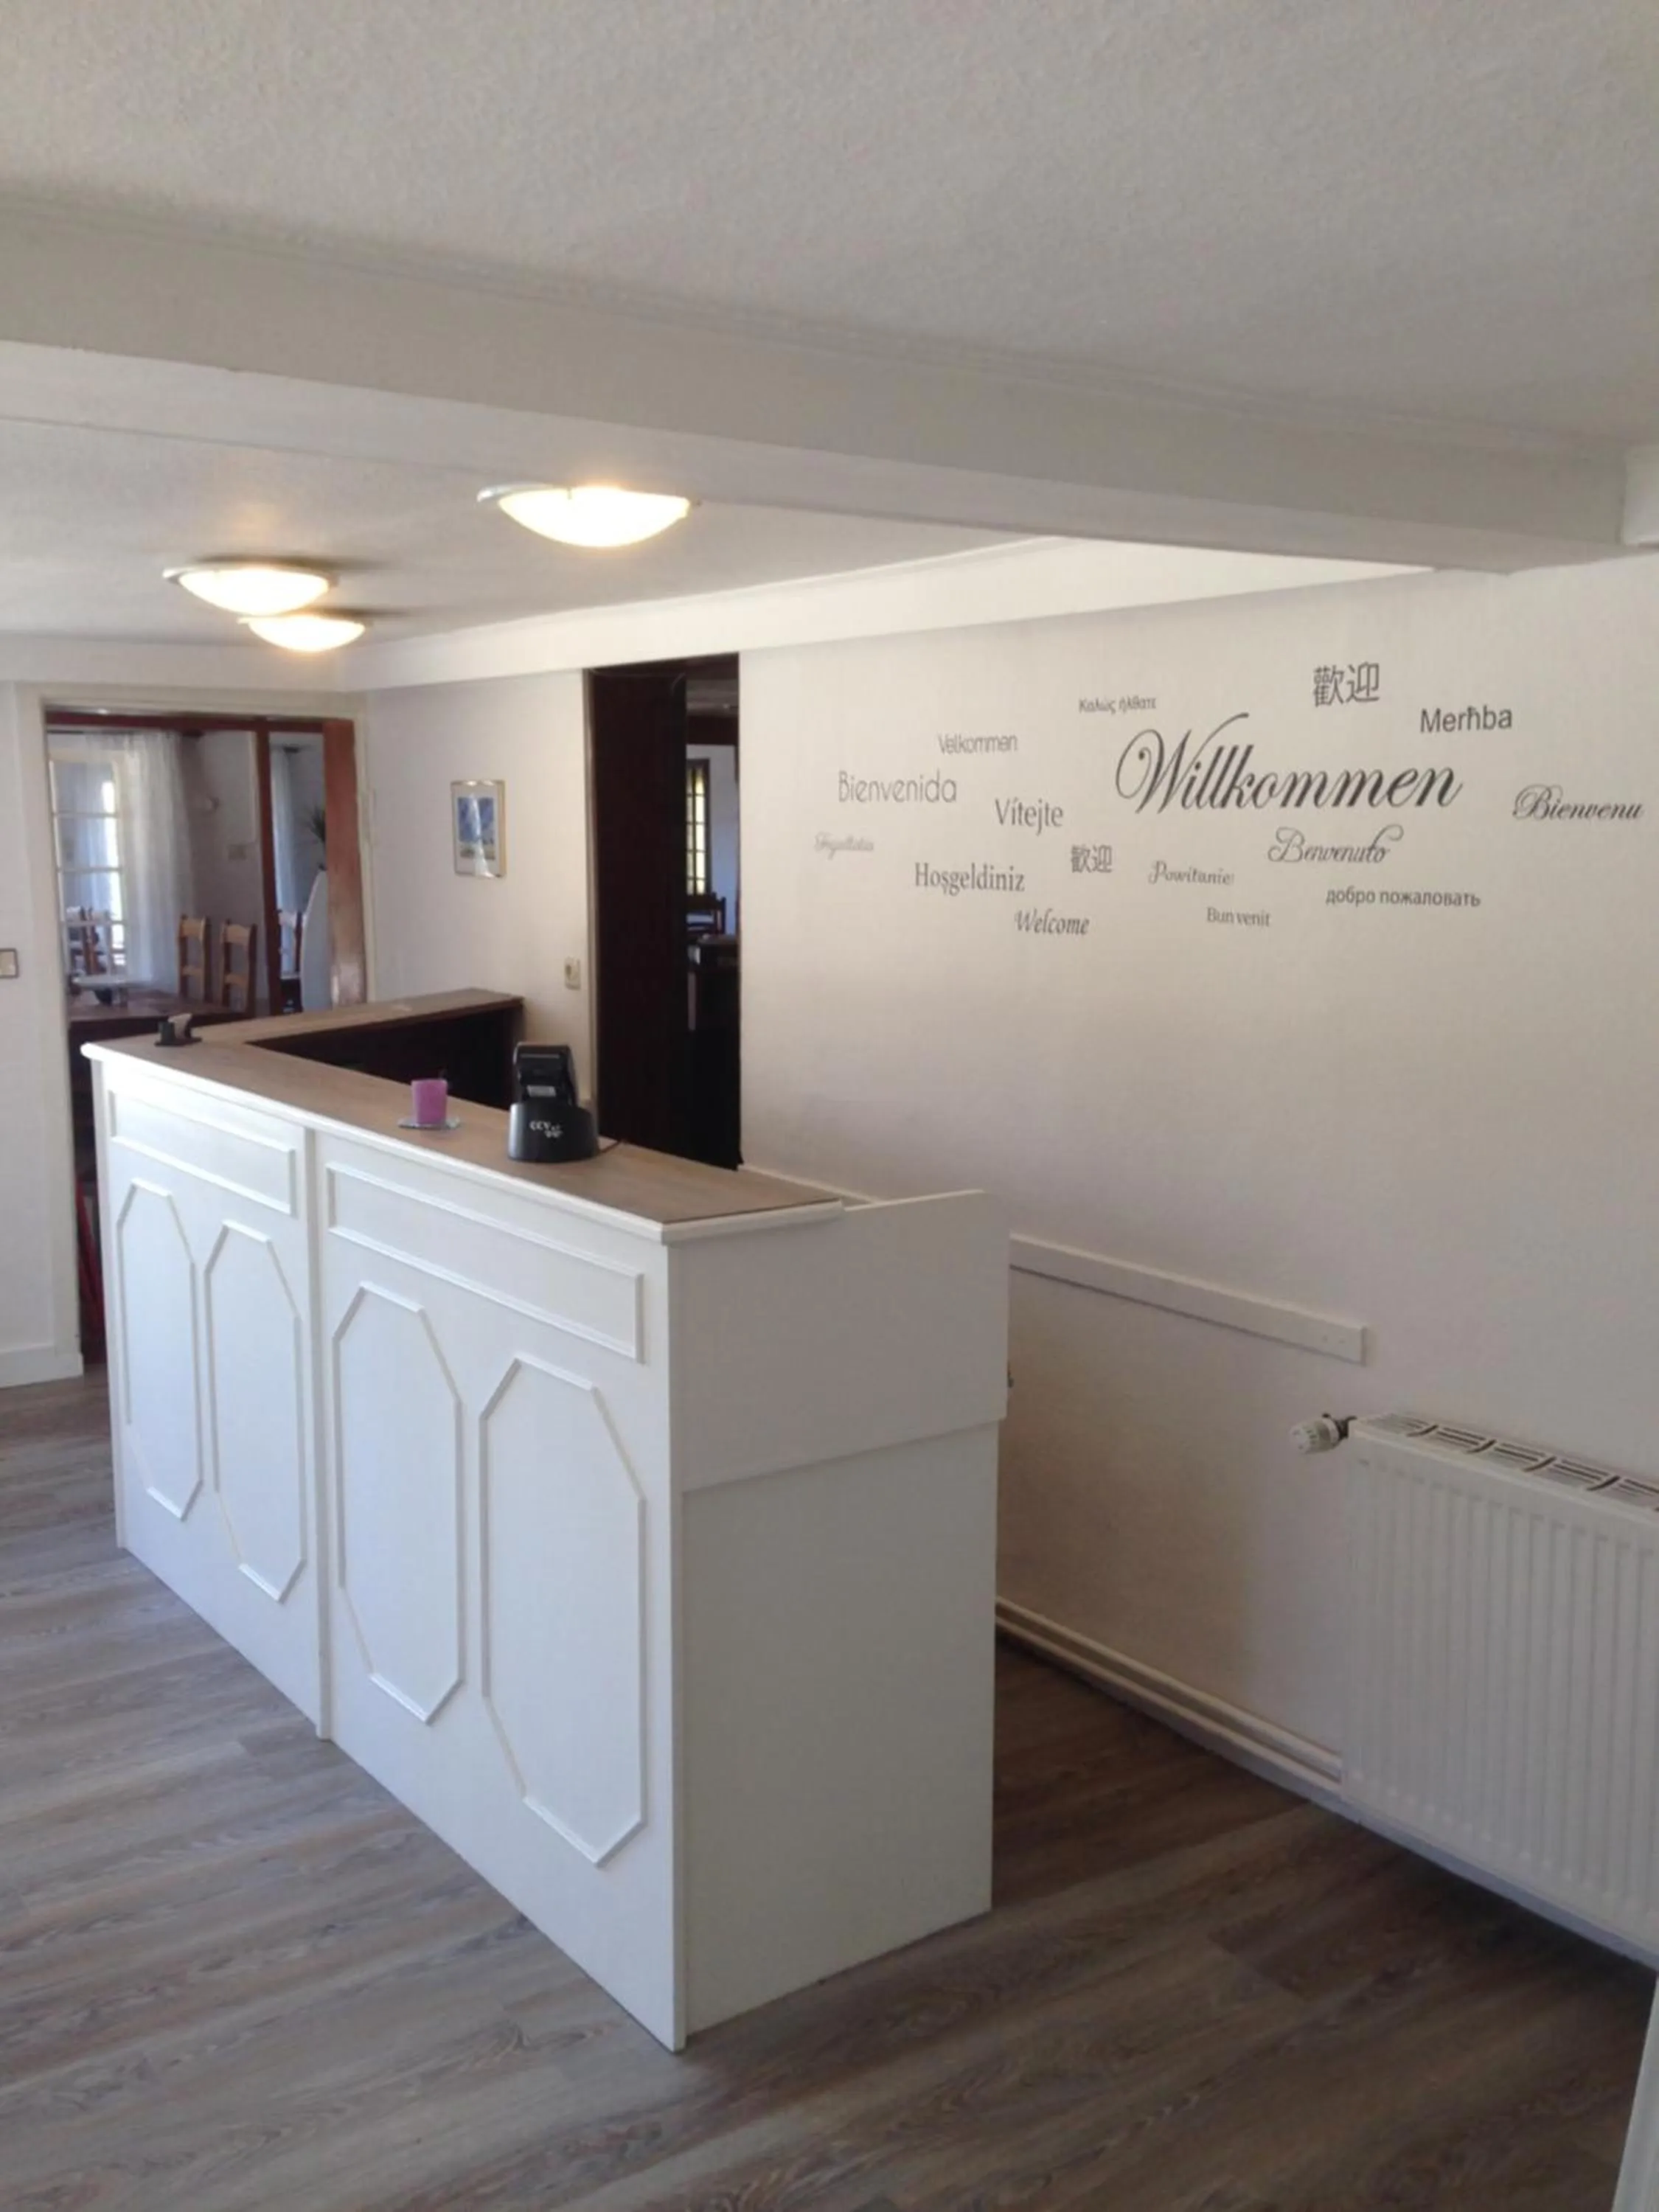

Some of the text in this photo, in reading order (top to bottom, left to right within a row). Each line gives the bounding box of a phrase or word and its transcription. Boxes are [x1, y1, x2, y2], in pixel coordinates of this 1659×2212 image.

[1312, 661, 1380, 708] 歡迎
[937, 733, 1018, 756] Velkommen
[1116, 712, 1464, 814] Willkommen
[838, 768, 958, 804] Bienvenida
[1512, 784, 1644, 821] Bienvenu
[994, 797, 1064, 836] Vítejte
[1267, 824, 1405, 863] Benvenuto
[1324, 885, 1482, 908] добро пожаловать
[1014, 908, 1091, 936] Welcome
